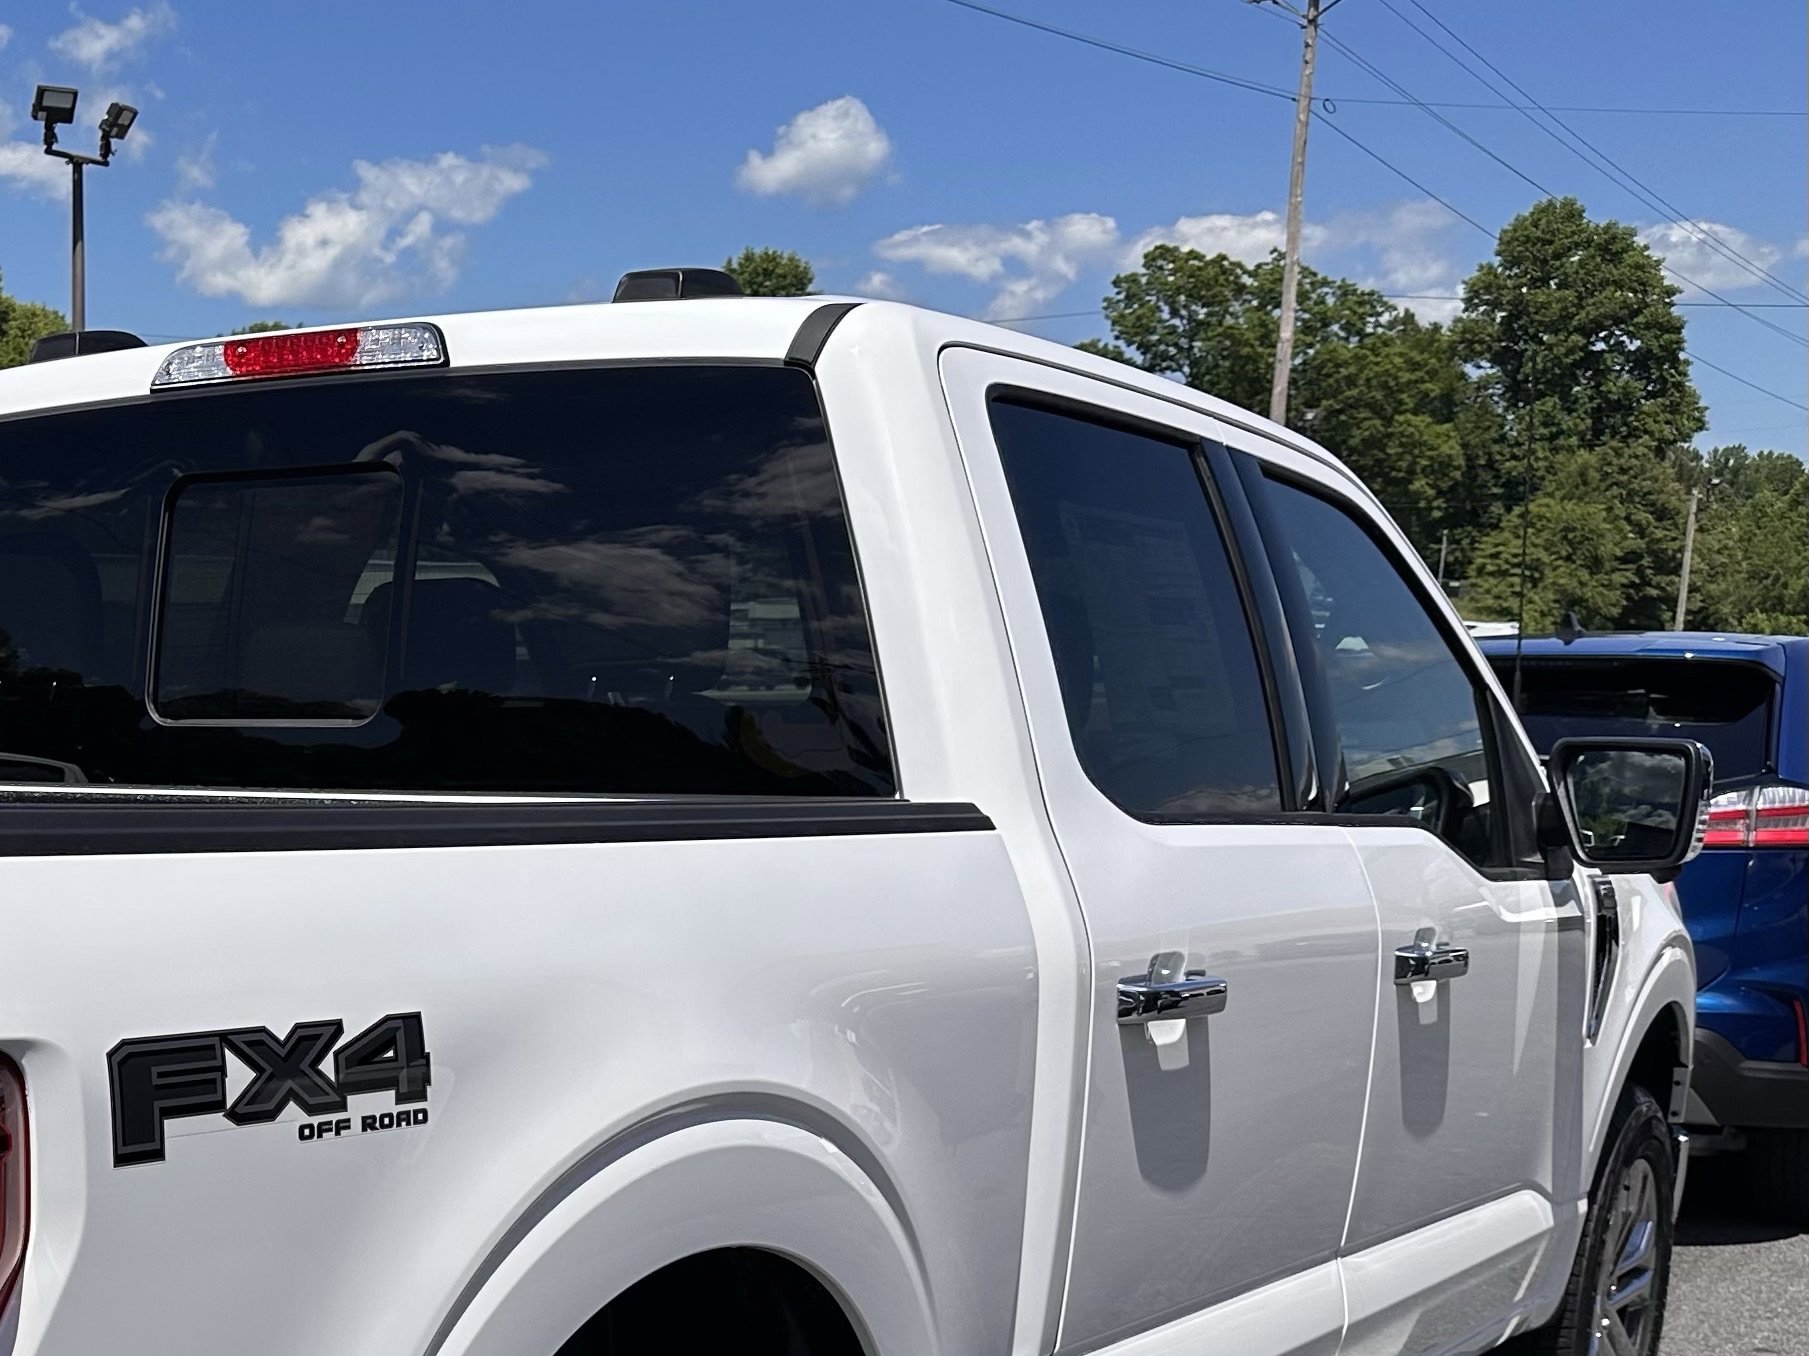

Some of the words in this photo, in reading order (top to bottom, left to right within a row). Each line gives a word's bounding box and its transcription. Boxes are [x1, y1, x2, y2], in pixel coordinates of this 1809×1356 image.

[105, 1010, 432, 1168] FX4
[298, 1117, 352, 1142] OFF
[361, 1107, 430, 1133] ROAD
